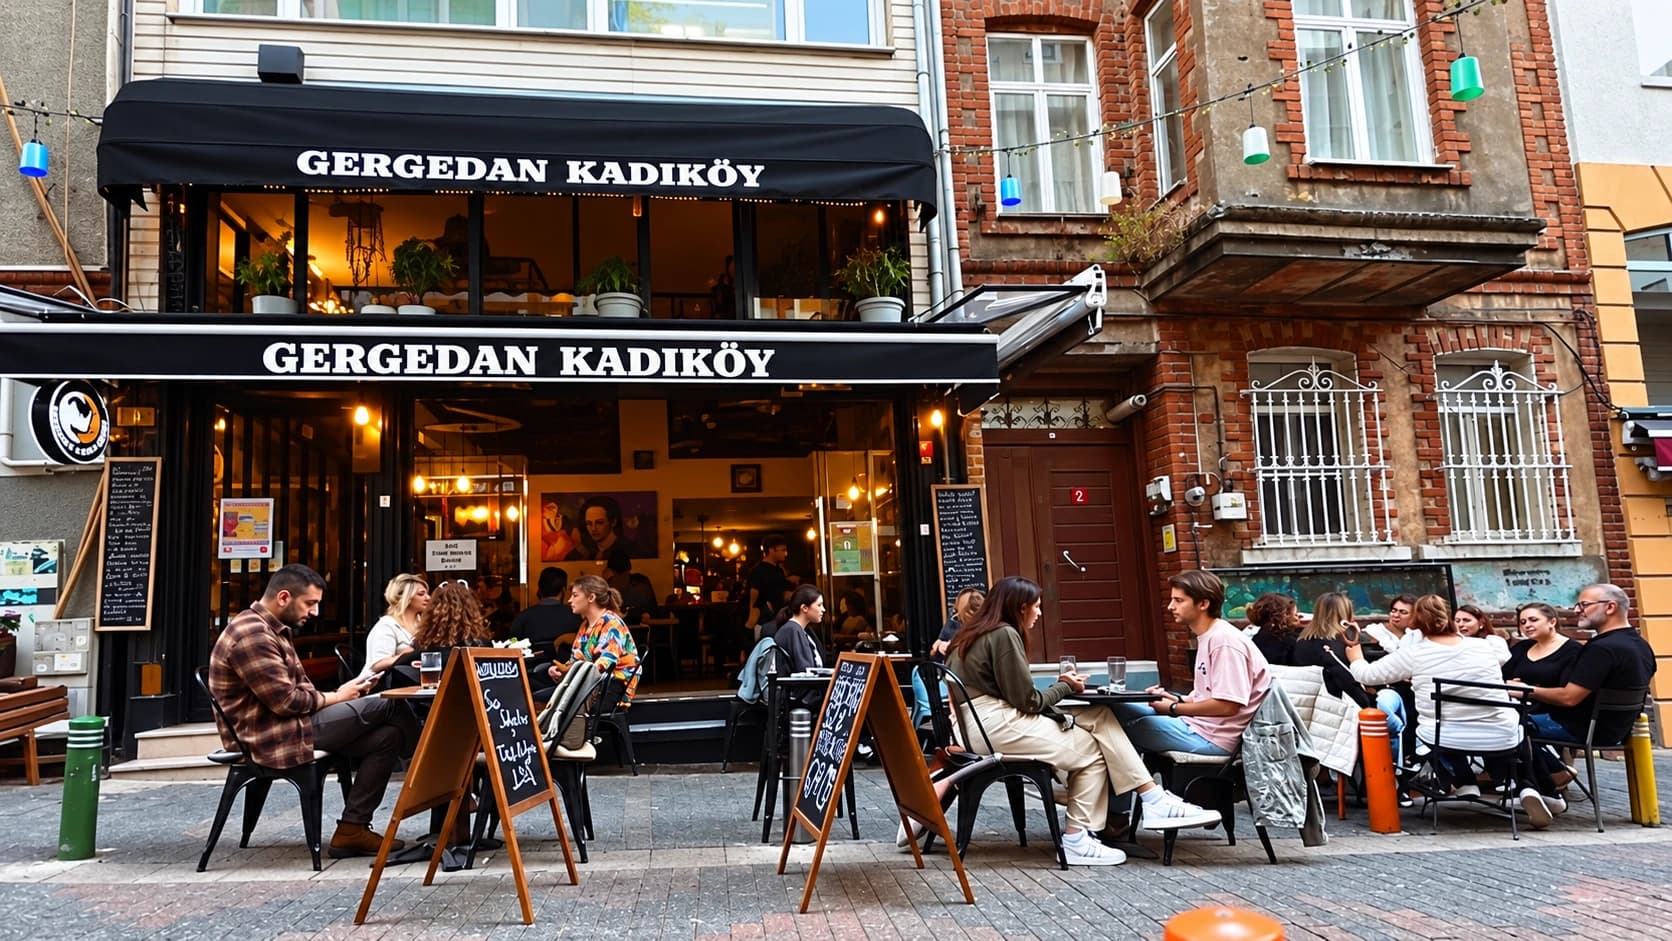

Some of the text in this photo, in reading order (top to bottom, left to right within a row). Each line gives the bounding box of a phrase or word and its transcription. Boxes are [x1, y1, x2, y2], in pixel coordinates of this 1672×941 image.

[297, 150, 765, 188] GERGEDAN KADIKÖY
[262, 341, 775, 378] GERGEDAN KADIKÖY
[1075, 490, 1084, 502] 2
